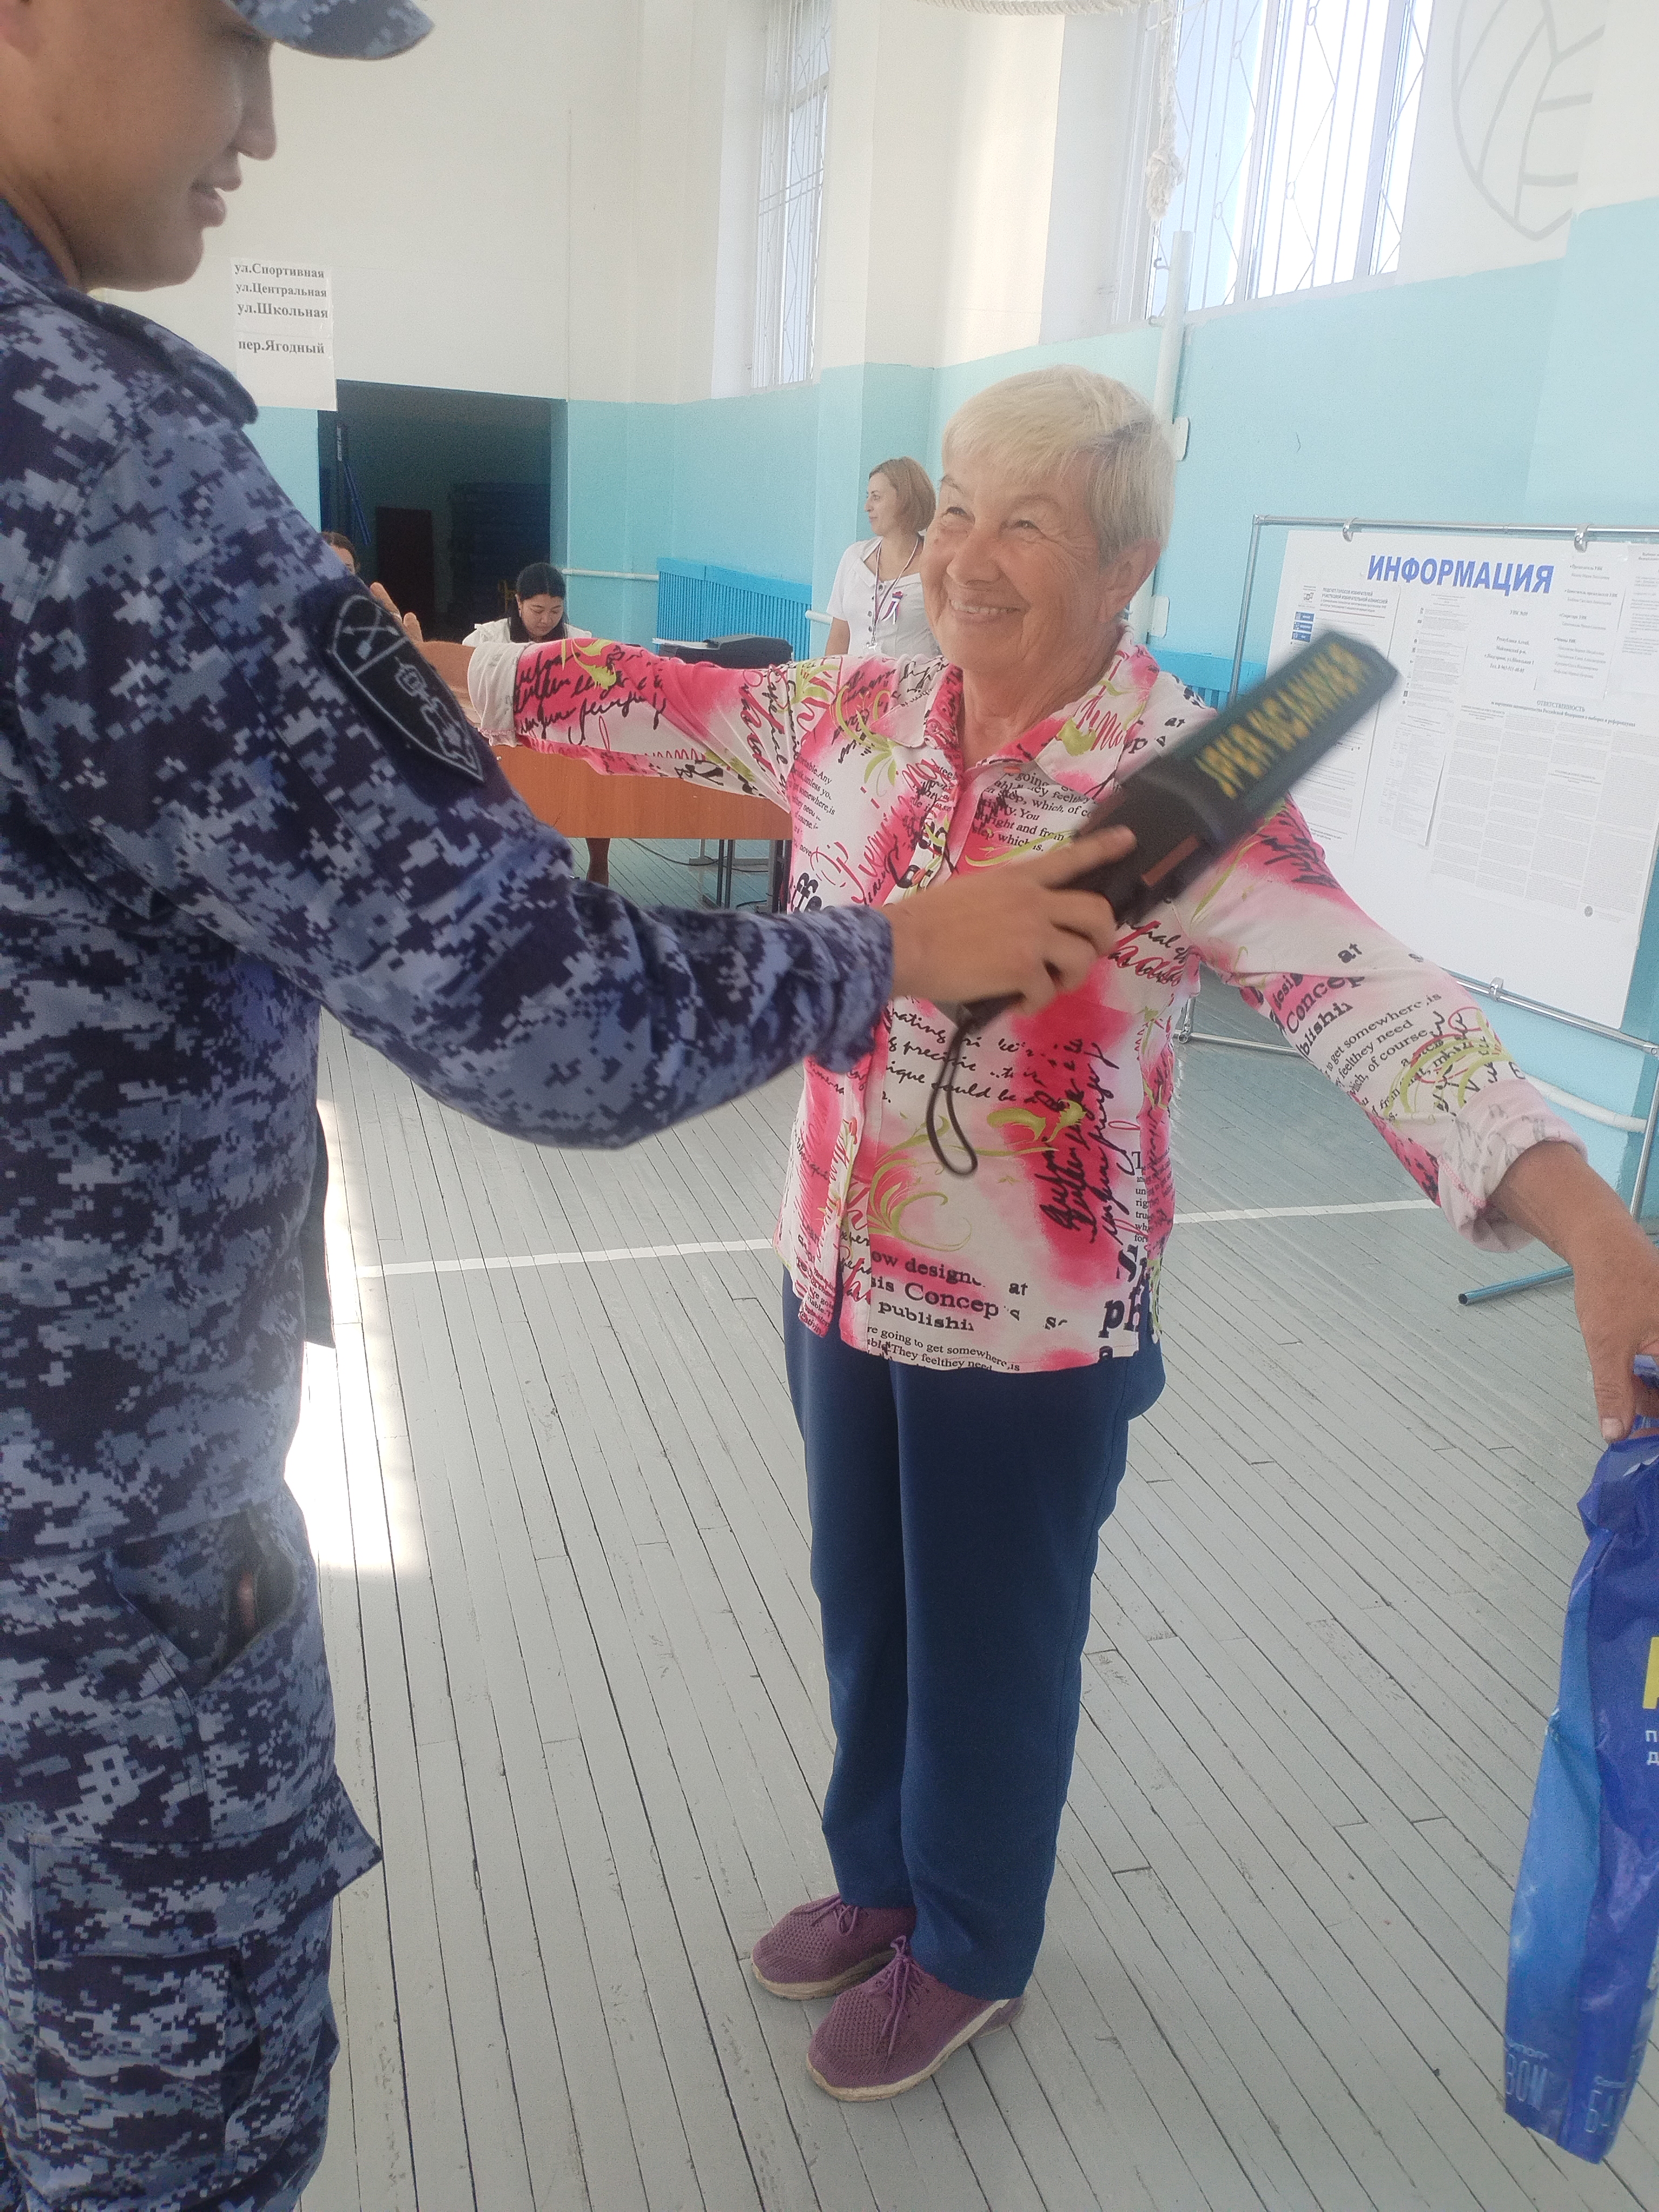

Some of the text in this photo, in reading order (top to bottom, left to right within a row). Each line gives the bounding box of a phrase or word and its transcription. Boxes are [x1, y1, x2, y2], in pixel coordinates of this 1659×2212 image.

[234, 263, 325, 278] ул.Спортивная
[236, 282, 327, 297] ул.Центральная
[237, 302, 328, 318] ул.Школьная
[238, 339, 325, 354] пер.Ягодный
[1367, 555, 1554, 596] ИНФОРМАЦИЯ
[881, 1330, 911, 1346] going
[914, 1339, 923, 1348] to
[926, 1343, 944, 1354] get
